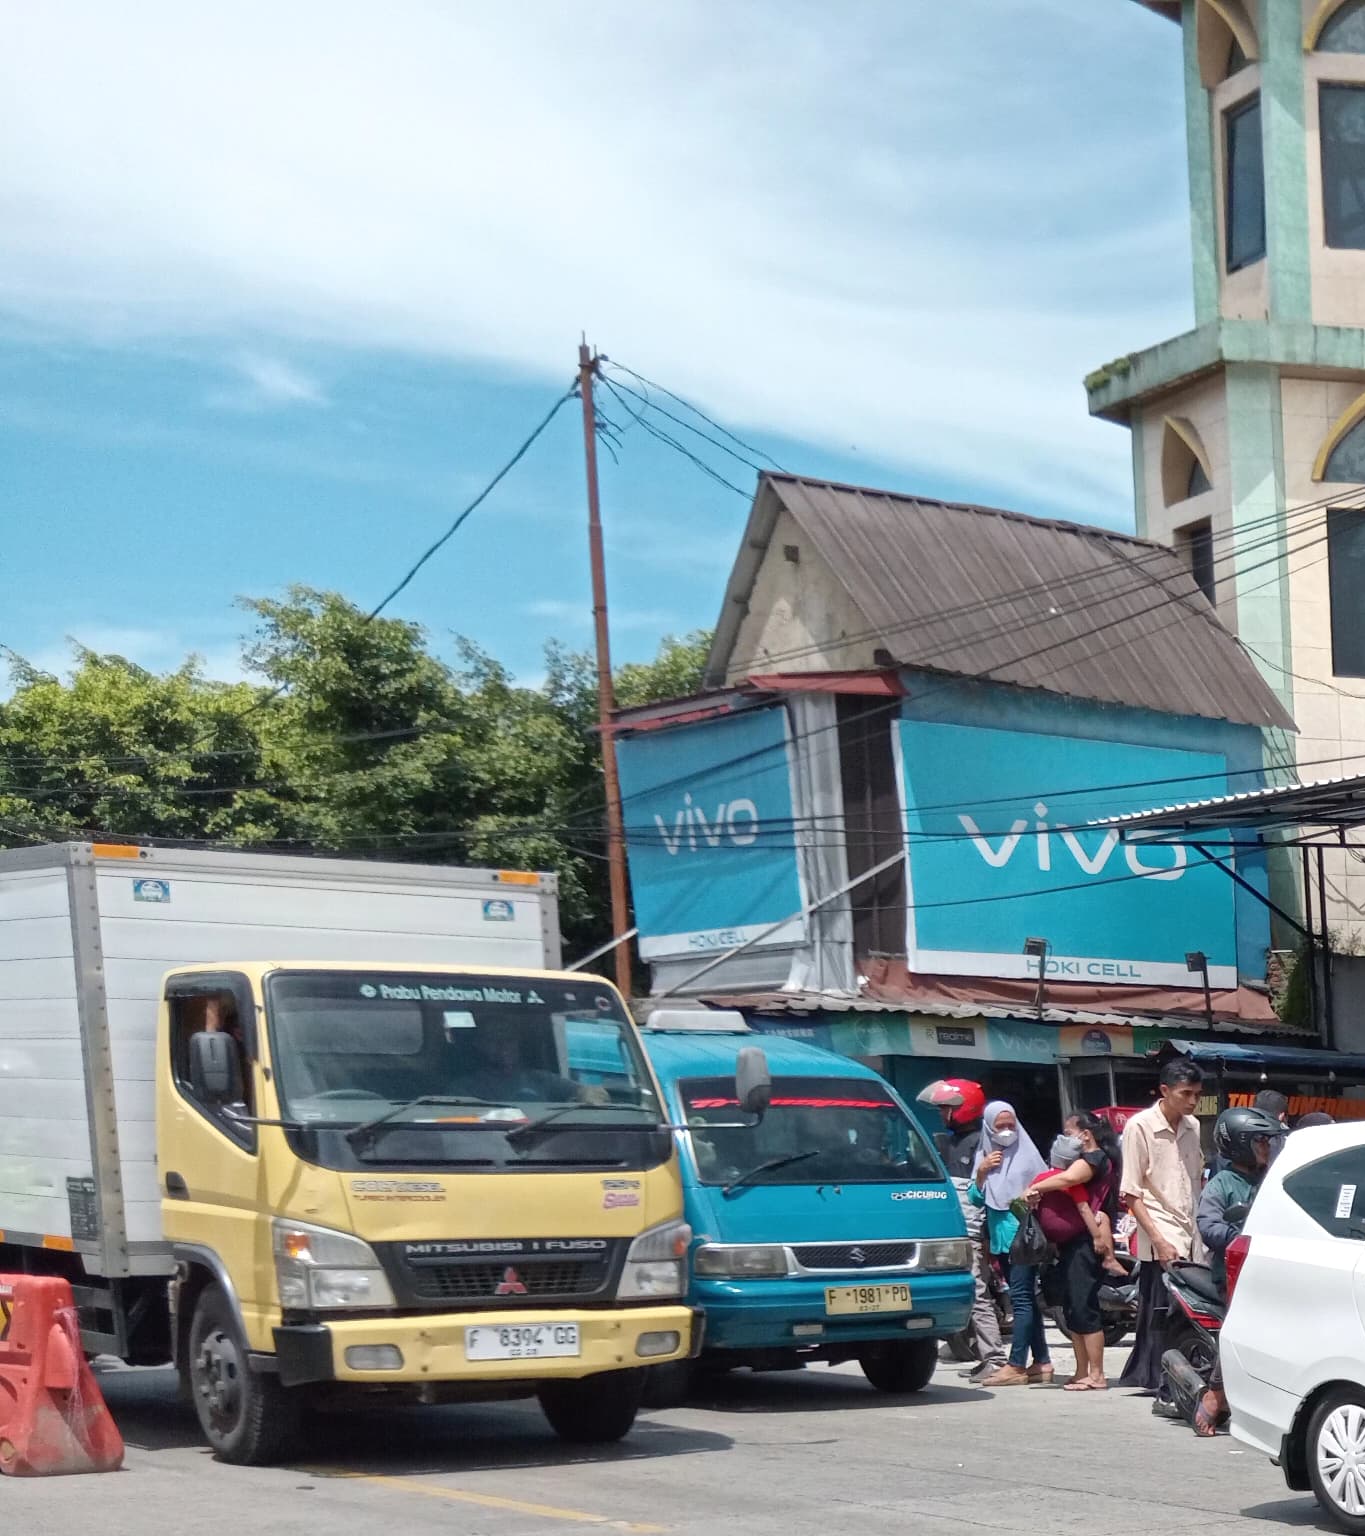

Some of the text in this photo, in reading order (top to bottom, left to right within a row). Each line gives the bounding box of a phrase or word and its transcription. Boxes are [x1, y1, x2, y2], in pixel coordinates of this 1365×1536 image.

[654, 792, 759, 855] vivo
[957, 801, 1187, 881] vivo
[1026, 958, 1142, 979] HOKI CELL
[380, 984, 421, 999] Prabu
[544, 1240, 607, 1250] FUSO
[828, 1285, 908, 1305] F 1981 PD
[469, 1326, 576, 1348] F 8394 GG
